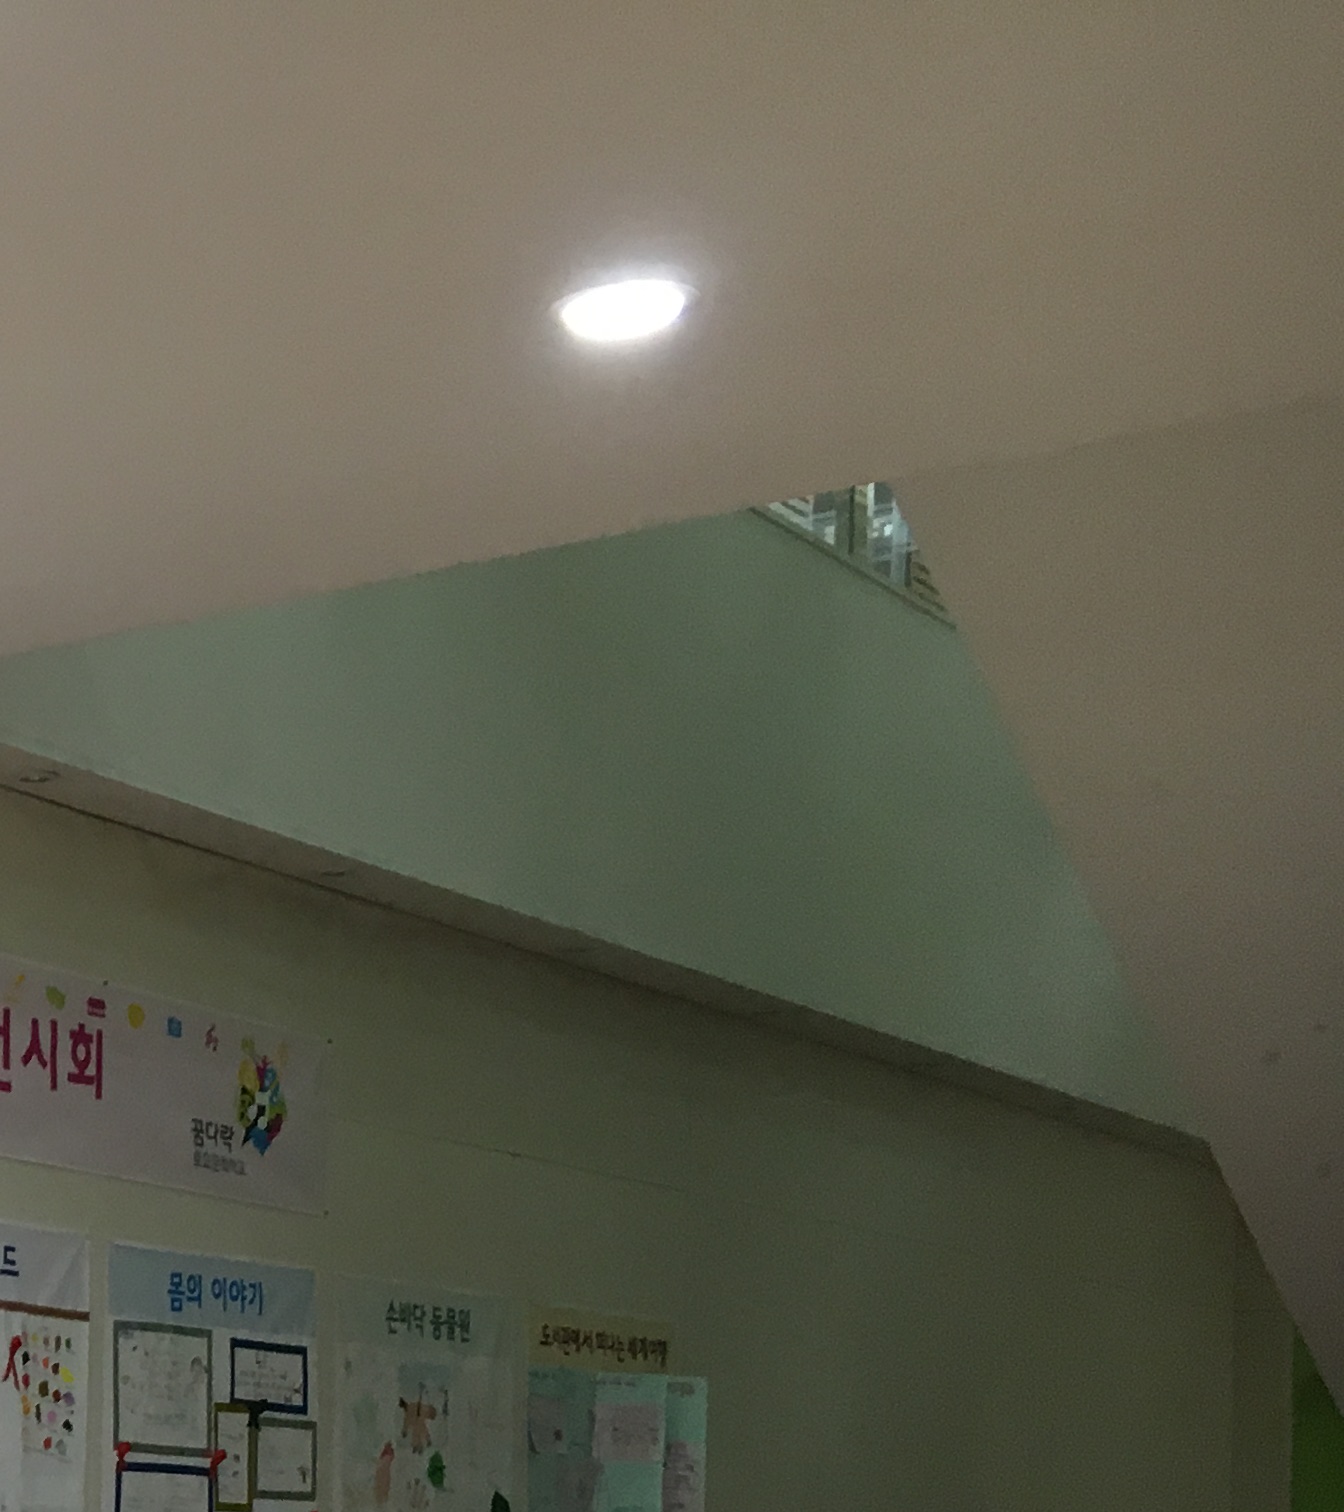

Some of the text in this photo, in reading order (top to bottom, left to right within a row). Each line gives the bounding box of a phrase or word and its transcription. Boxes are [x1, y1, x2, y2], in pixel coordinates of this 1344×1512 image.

[191, 1117, 235, 1153] 꿈다락
[167, 1271, 265, 1316] 몸의 이야기
